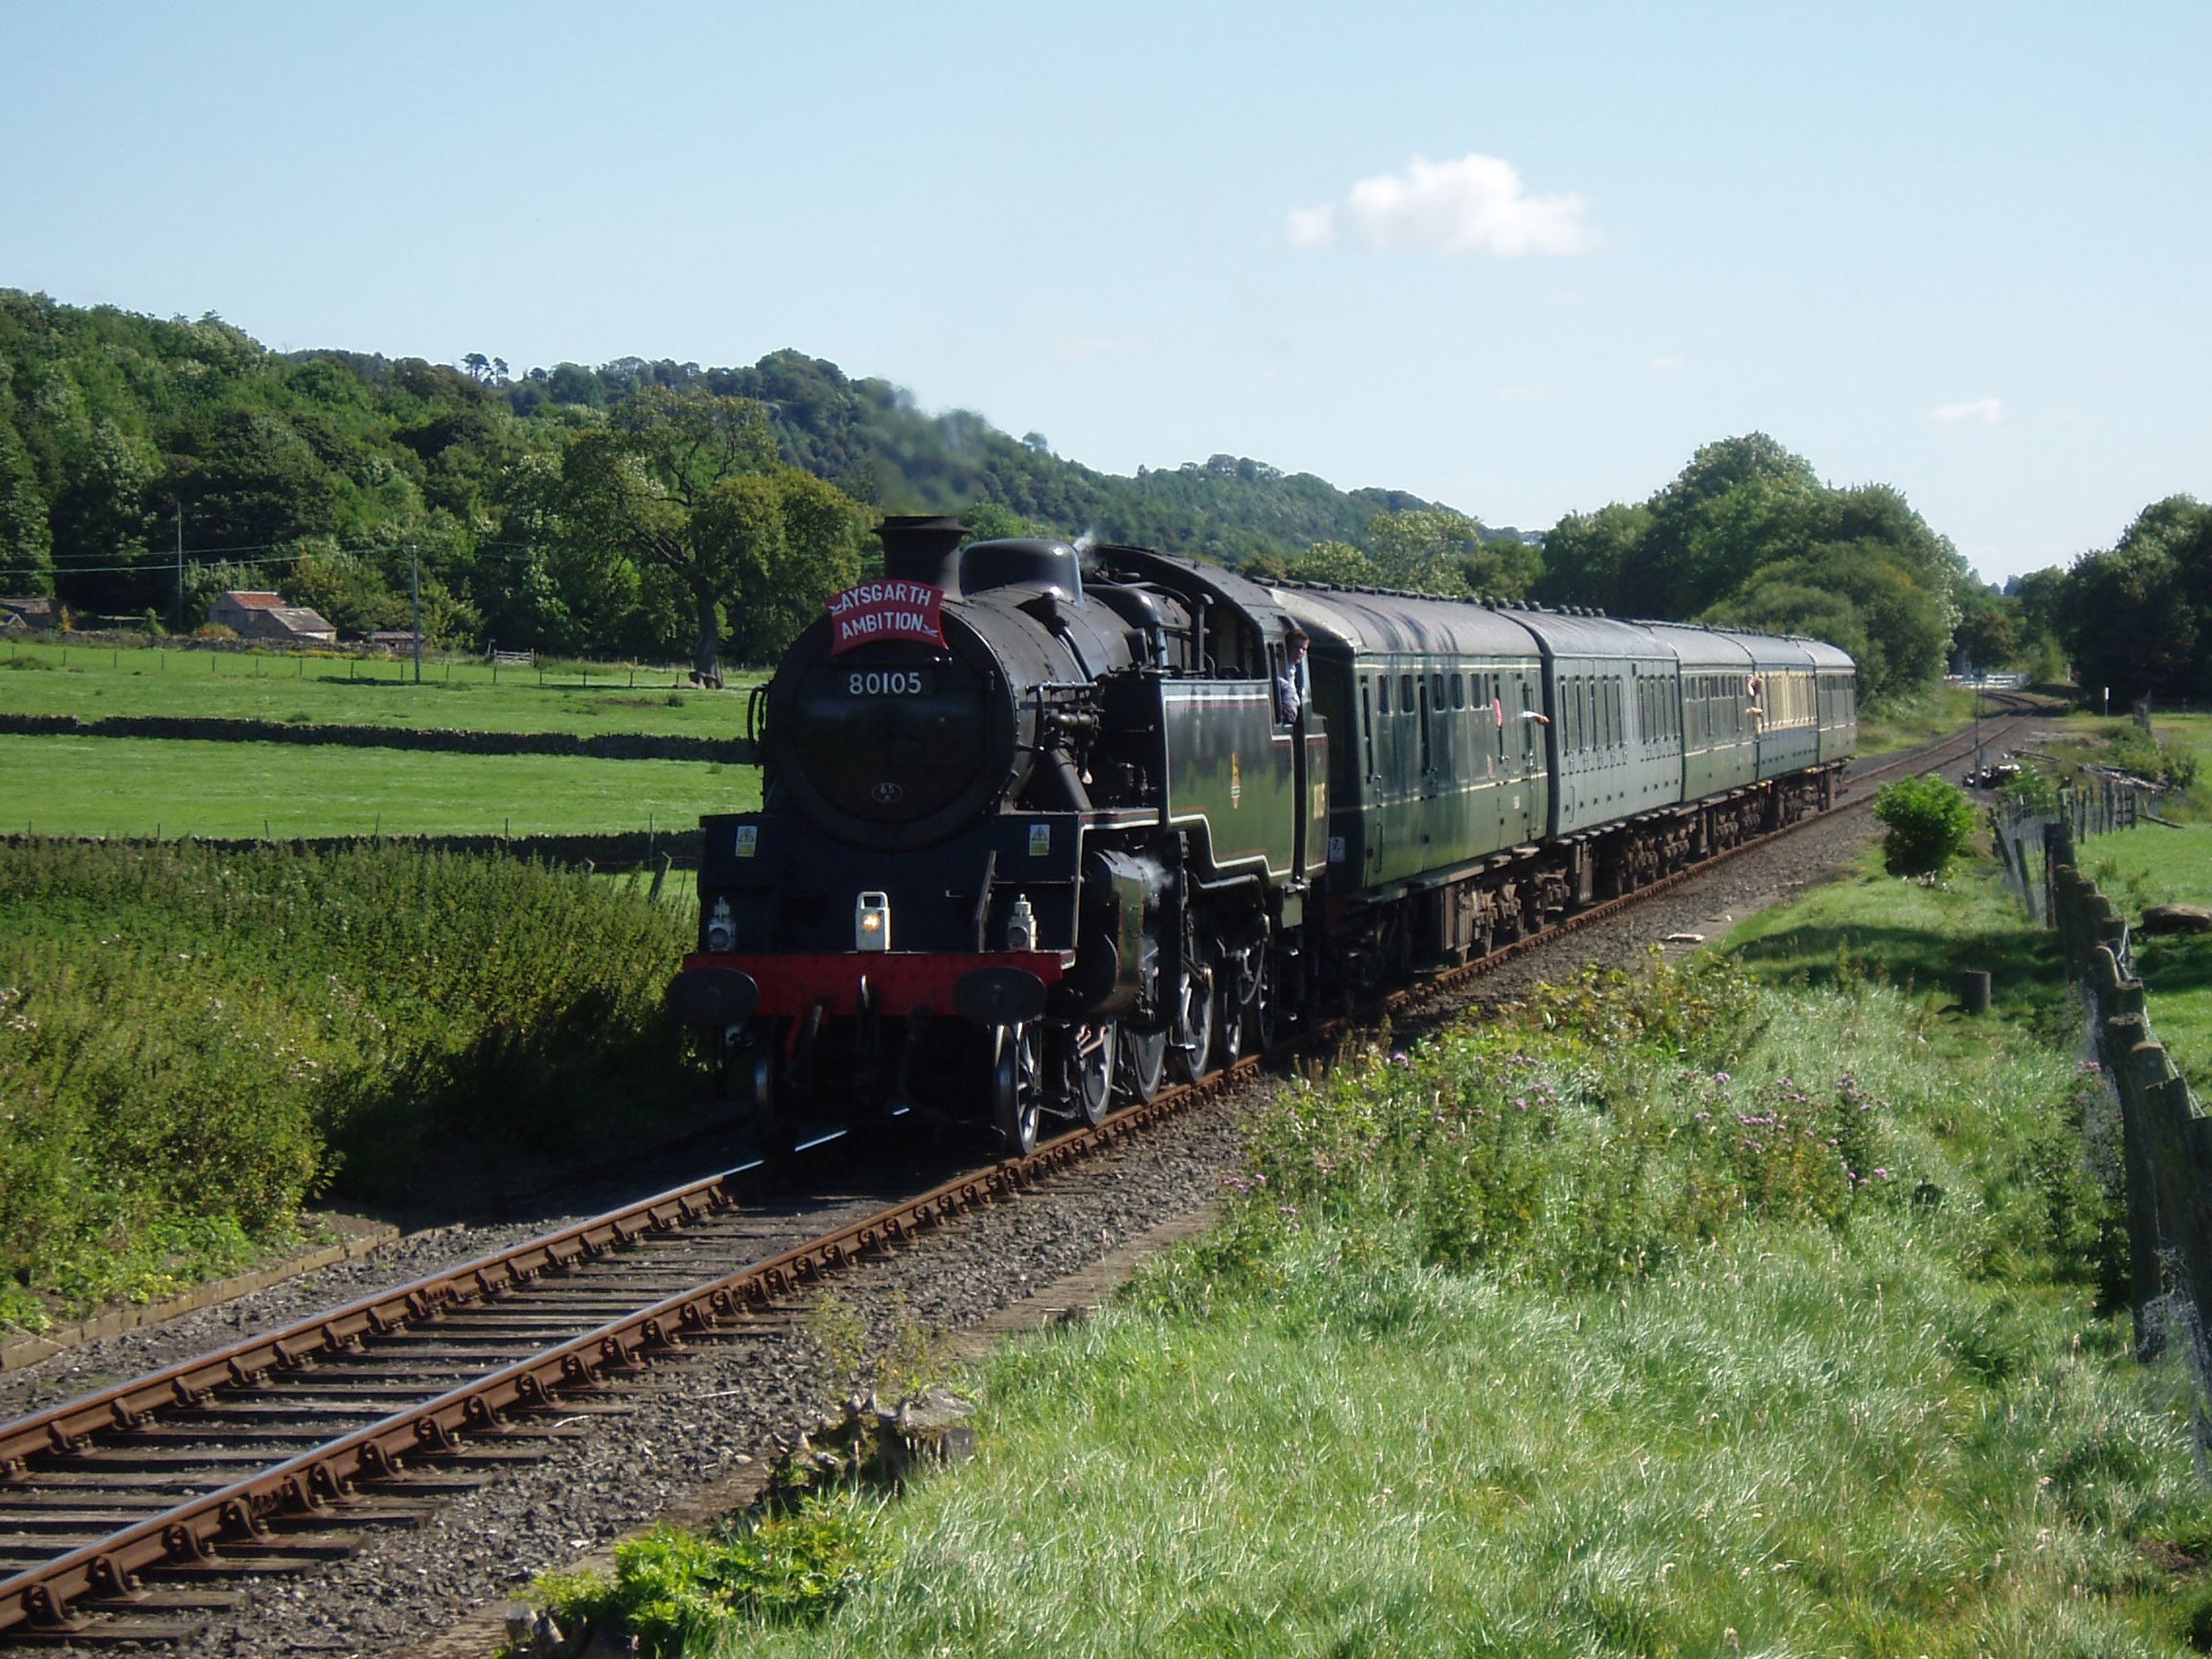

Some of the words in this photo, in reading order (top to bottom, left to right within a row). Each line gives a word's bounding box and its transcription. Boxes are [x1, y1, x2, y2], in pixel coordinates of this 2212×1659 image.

[841, 583, 931, 611] AYSGARTH
[842, 611, 924, 639] AMBITION
[849, 672, 922, 695] 80105
